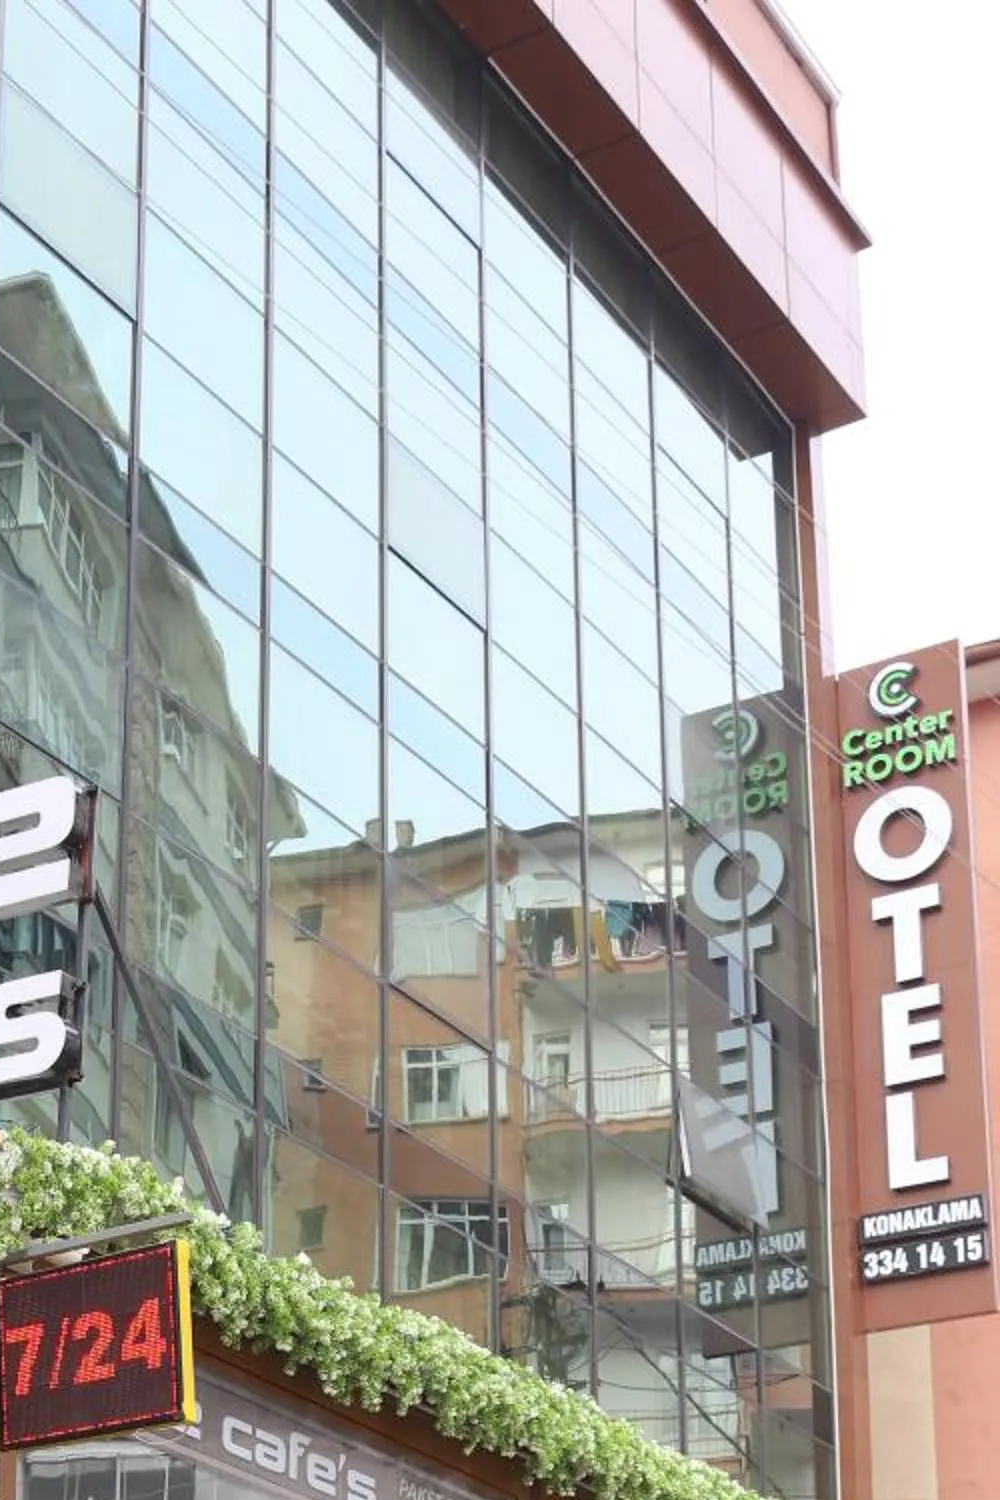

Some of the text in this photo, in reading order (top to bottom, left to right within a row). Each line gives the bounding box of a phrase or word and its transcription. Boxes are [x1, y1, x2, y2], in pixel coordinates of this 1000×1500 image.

[842, 708, 954, 757] Center
[843, 734, 956, 788] ROOM
[853, 784, 953, 1191] OTEL
[863, 1198, 983, 1239] KONAKLAMA
[863, 1234, 983, 1279] 334 14 15
[5, 1296, 168, 1397] 7/24
